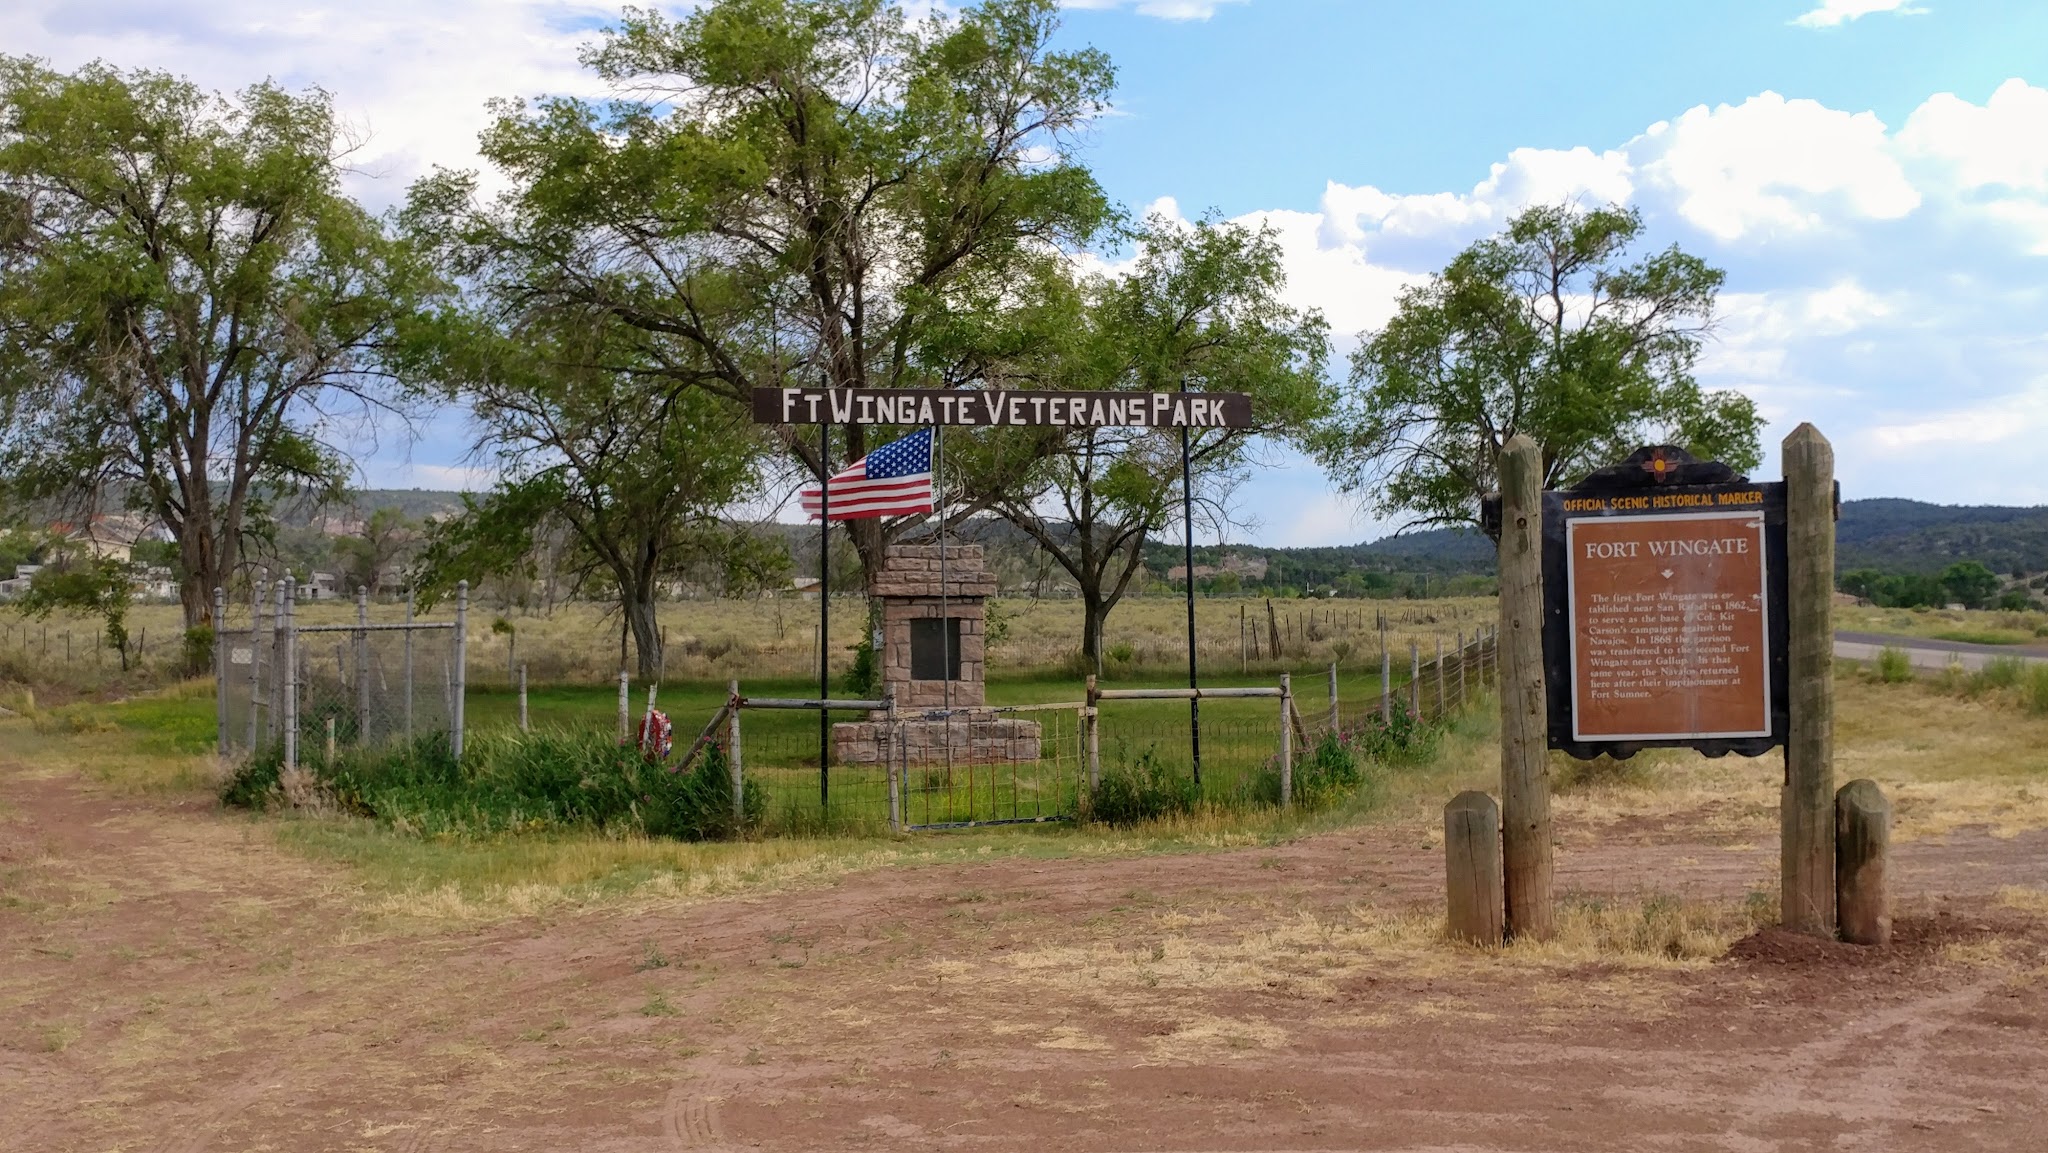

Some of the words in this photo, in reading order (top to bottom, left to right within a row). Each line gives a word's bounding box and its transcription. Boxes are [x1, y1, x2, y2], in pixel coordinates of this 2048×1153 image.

[782, 388, 822, 423] FT
[829, 388, 975, 425] WINGATE
[985, 391, 1146, 426] VETERANS
[1152, 392, 1226, 427] PARK
[1563, 499, 1607, 512] OFFICIAL
[1610, 497, 1649, 510] SCENIC
[1653, 494, 1714, 509] HISTORICAL
[1718, 491, 1763, 505] MARKER
[1585, 542, 1640, 559] FORT
[1648, 537, 1749, 557] WINGATE
[1591, 593, 1609, 603] The
[1613, 592, 1631, 602] first
[1636, 592, 1655, 602] Fort
[1659, 591, 1697, 602] Wingate
[1701, 592, 1718, 600] was
[1589, 603, 1629, 614] tablished
[1657, 603, 1674, 612] San
[1711, 601, 1721, 610] in
[1589, 616, 1599, 624] to
[1602, 616, 1625, 624] serve
[1641, 614, 1656, 623] the
[1660, 613, 1680, 623] base
[1697, 612, 1716, 621] Col.
[1720, 611, 1735, 621] Kit
[1589, 625, 1627, 635] Carson's
[1631, 624, 1678, 635] campaigns
[1718, 622, 1733, 632] the
[1636, 635, 1646, 644] In
[1650, 635, 1672, 644] 1868
[1675, 634, 1690, 644] the
[1610, 645, 1660, 656] transferred
[1664, 646, 1673, 654] to
[1677, 645, 1692, 654] the
[1696, 644, 1726, 653] second
[1730, 643, 1750, 653] Fort
[1590, 657, 1629, 668] Wingate
[1712, 654, 1731, 664] that
[1641, 667, 1656, 676] the
[1700, 664, 1739, 675] returned
[1591, 678, 1610, 688] here
[1613, 678, 1636, 688] after
[1640, 678, 1661, 687] their
[1665, 676, 1728, 688] imprisonment
[1732, 677, 1741, 685] at
[1591, 690, 1610, 699] Fort
[1613, 688, 1652, 699] Sumner.
